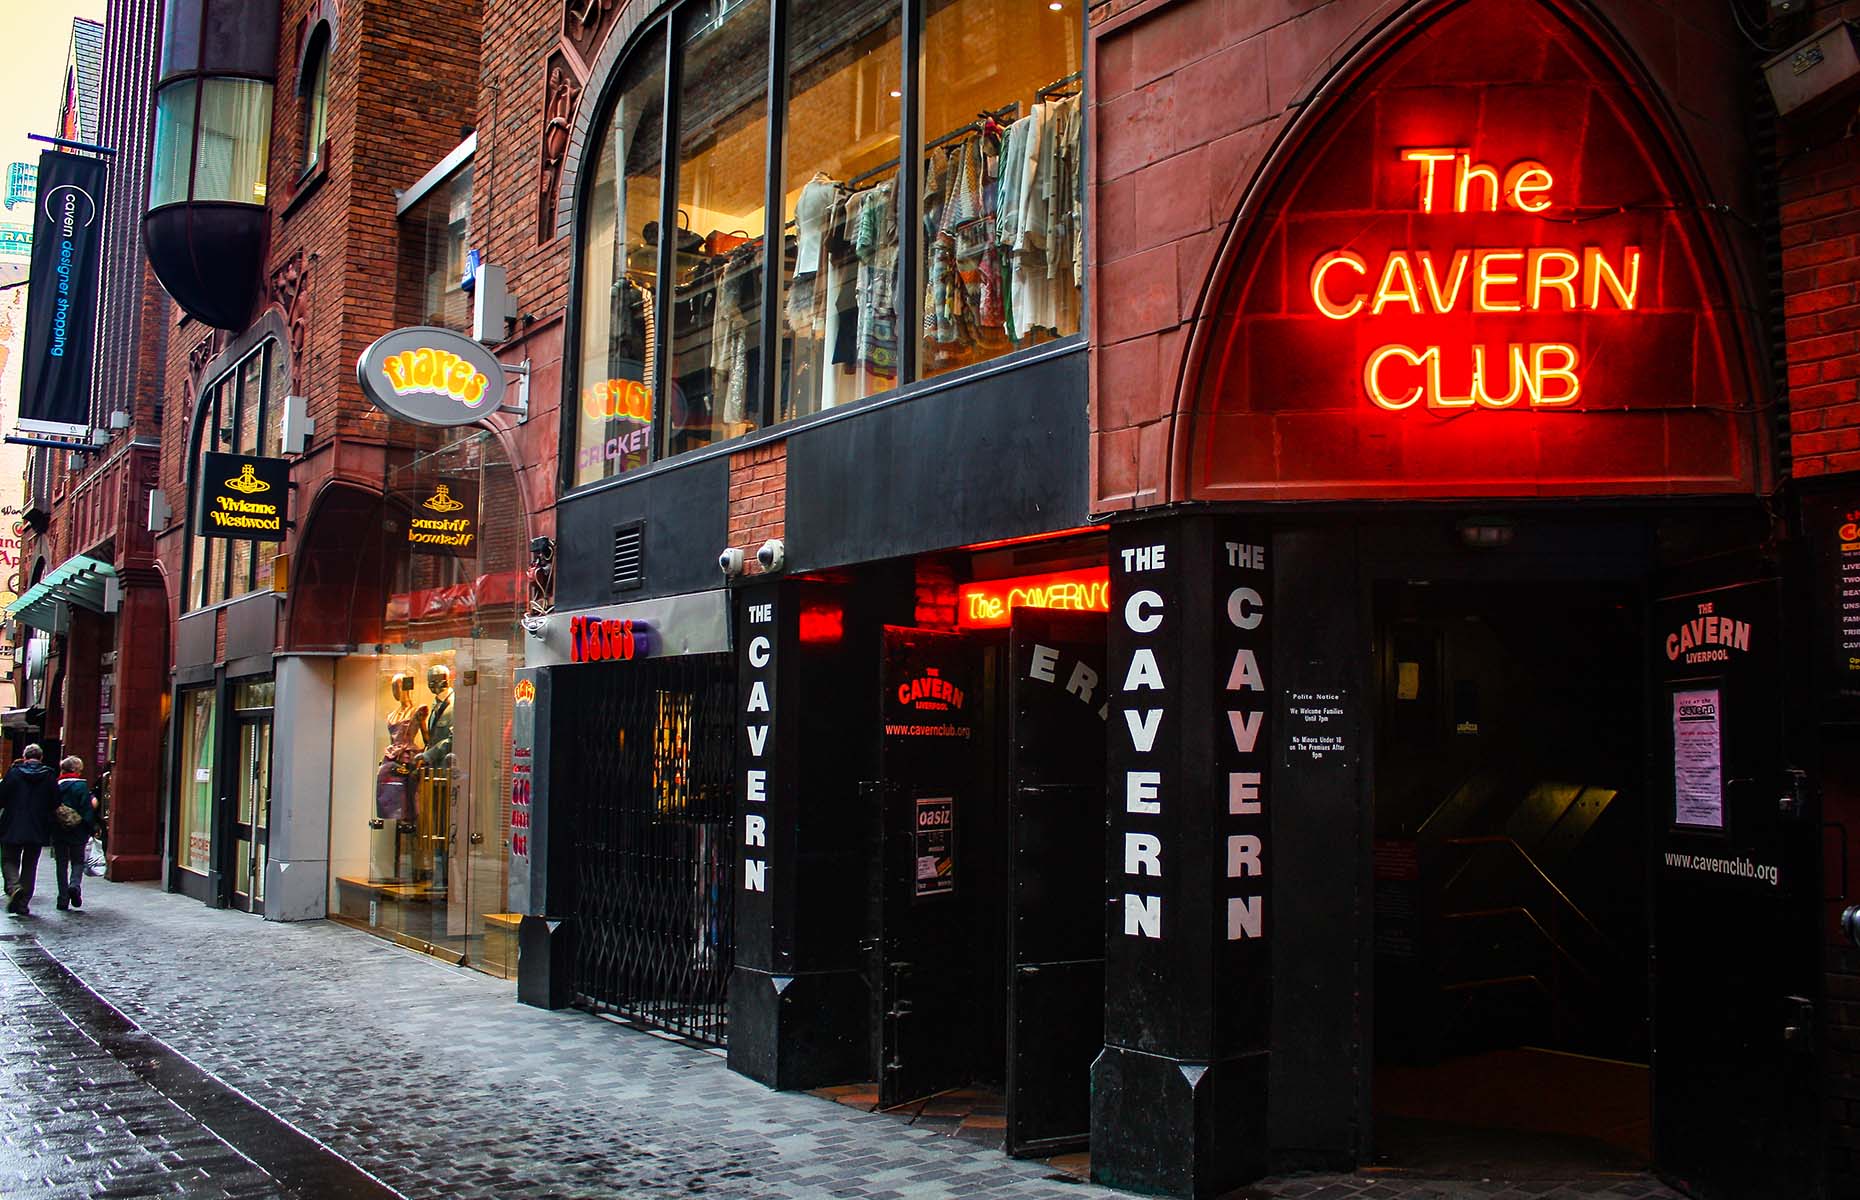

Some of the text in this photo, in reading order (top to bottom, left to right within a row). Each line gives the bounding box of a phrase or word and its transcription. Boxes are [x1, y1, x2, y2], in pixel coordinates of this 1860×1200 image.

[1401, 146, 1554, 214] The
[50, 193, 76, 358] cavern designer shopping
[1309, 246, 1640, 320] CAVERN
[382, 347, 491, 409] flares
[1363, 343, 1581, 410] CLUB
[210, 510, 281, 530] Westwood
[216, 495, 277, 515] Vivienne
[1121, 544, 1166, 572] THE
[1225, 541, 1264, 570] THE
[749, 604, 772, 624] THE
[968, 593, 1004, 619] The
[1698, 602, 1713, 615] THE
[568, 615, 636, 663] flares
[1666, 616, 1752, 661] CAVERN
[1686, 649, 1729, 664] LIVERPOOL
[898, 677, 965, 710] CAVERN
[1029, 644, 1109, 721] ER
[915, 701, 949, 712] LIVERPOOL
[885, 723, 972, 740] www.cavernclub.org
[744, 636, 771, 893] CAVERN
[1123, 590, 1166, 940] CAVERN
[1225, 587, 1264, 940] CAVERN
[919, 810, 951, 826] oasiz
[1664, 852, 1778, 886] www.cavernclub.org
